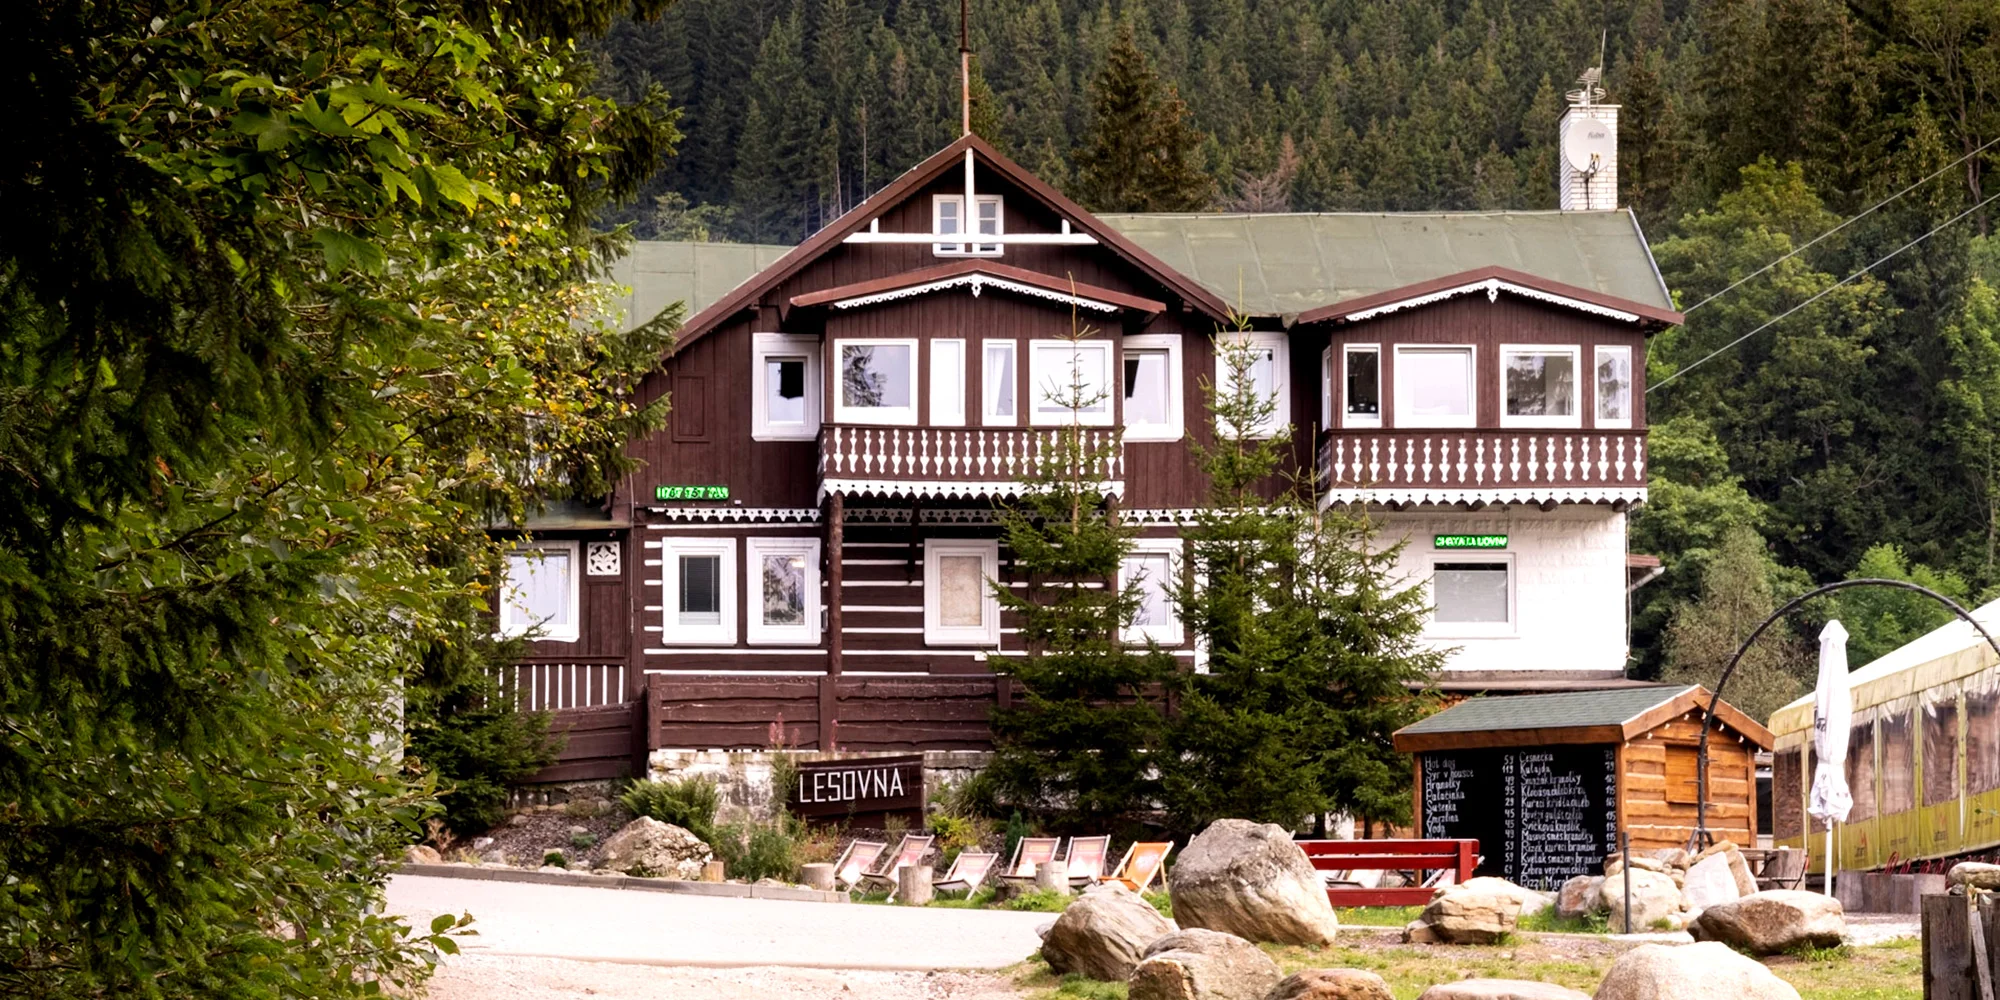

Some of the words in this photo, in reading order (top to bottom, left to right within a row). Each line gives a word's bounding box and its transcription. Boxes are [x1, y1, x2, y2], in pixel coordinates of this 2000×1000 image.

[1424, 755, 1440, 769] Hot
[1442, 757, 1455, 770] dog
[799, 767, 904, 803] LESOVNA
[1425, 777, 1461, 793] Hranolky
[1504, 785, 1515, 796] 95
[1505, 797, 1515, 807] 29
[1504, 808, 1515, 818] 45
[1426, 821, 1446, 833] Voda
[1504, 819, 1515, 829] 45
